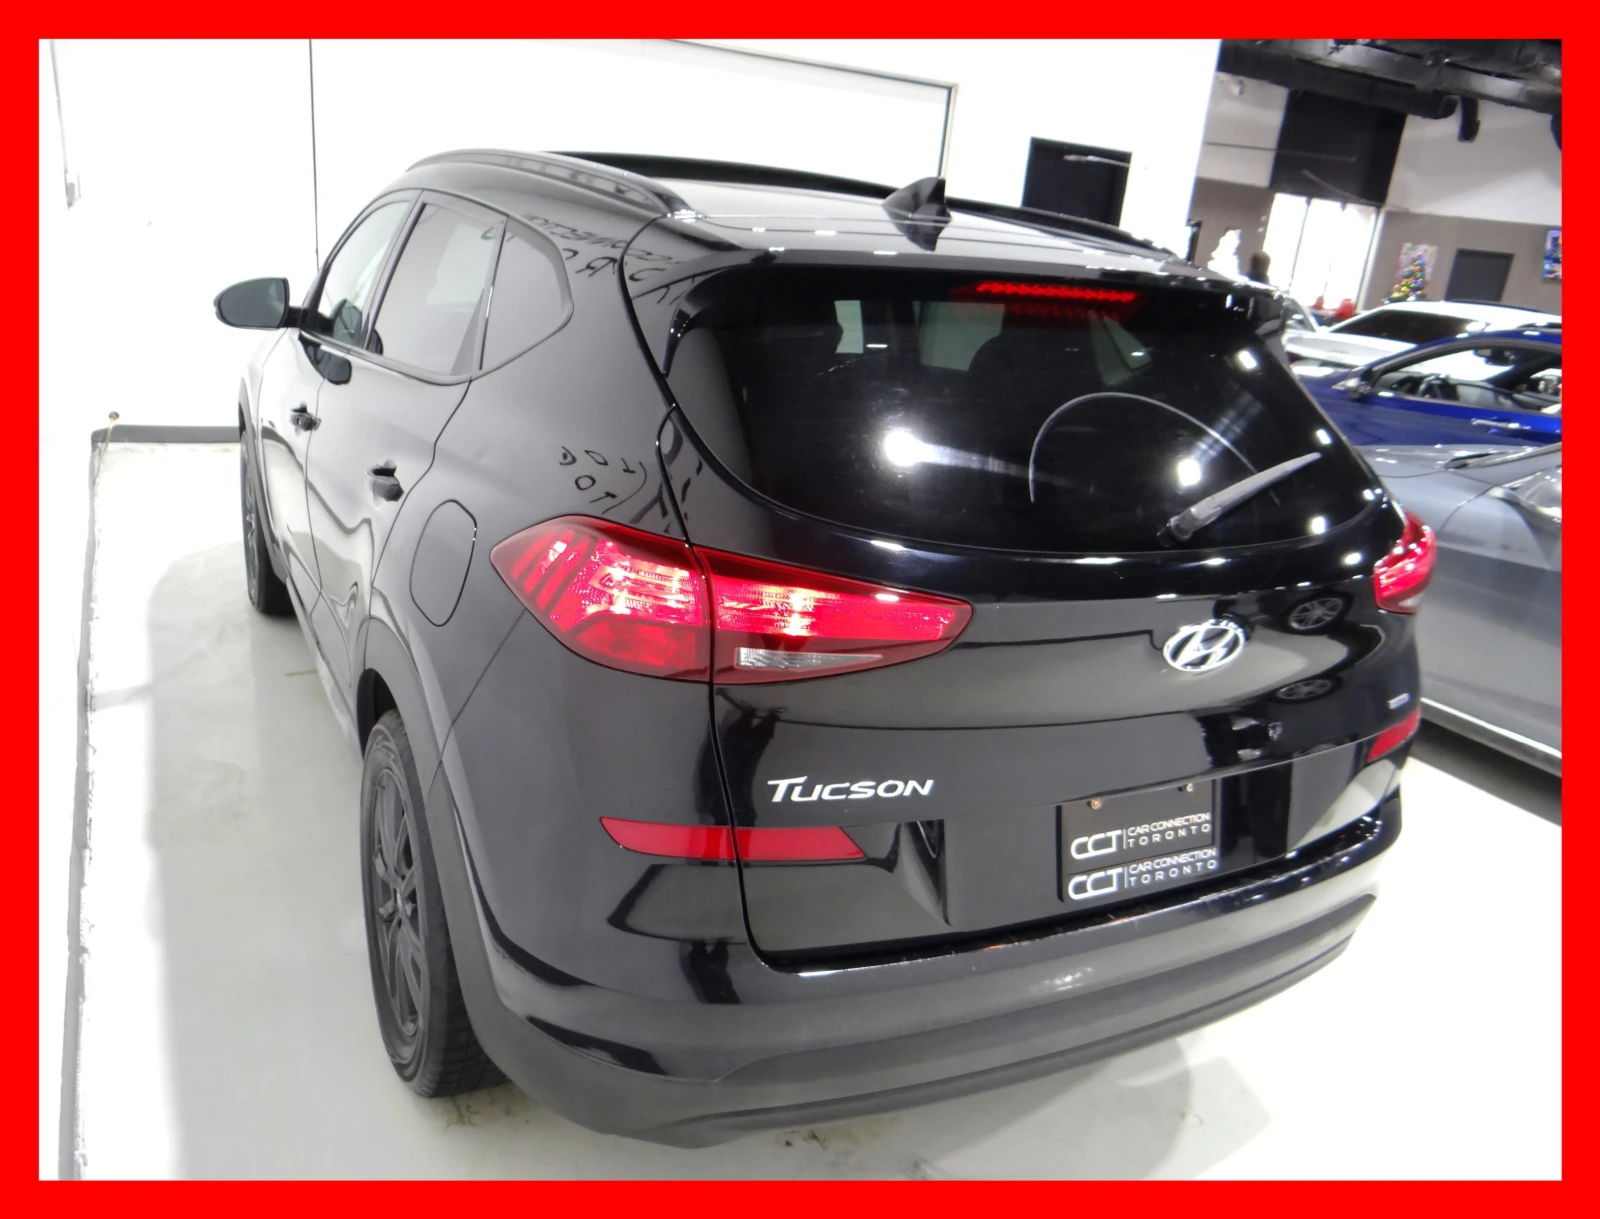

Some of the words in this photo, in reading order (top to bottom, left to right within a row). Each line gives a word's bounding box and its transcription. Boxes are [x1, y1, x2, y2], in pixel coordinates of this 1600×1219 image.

[767, 775, 934, 803] TUCSON
[1127, 823, 1150, 837] CAR
[1150, 811, 1211, 831] CONNECTION
[1127, 823, 1211, 849] TORONTO
[1070, 829, 1122, 860] CCT
[1128, 860, 1153, 874] CAR
[1153, 847, 1216, 868] CONNECTION
[1129, 859, 1217, 887] TORONTO
[1067, 867, 1123, 900] CCT
